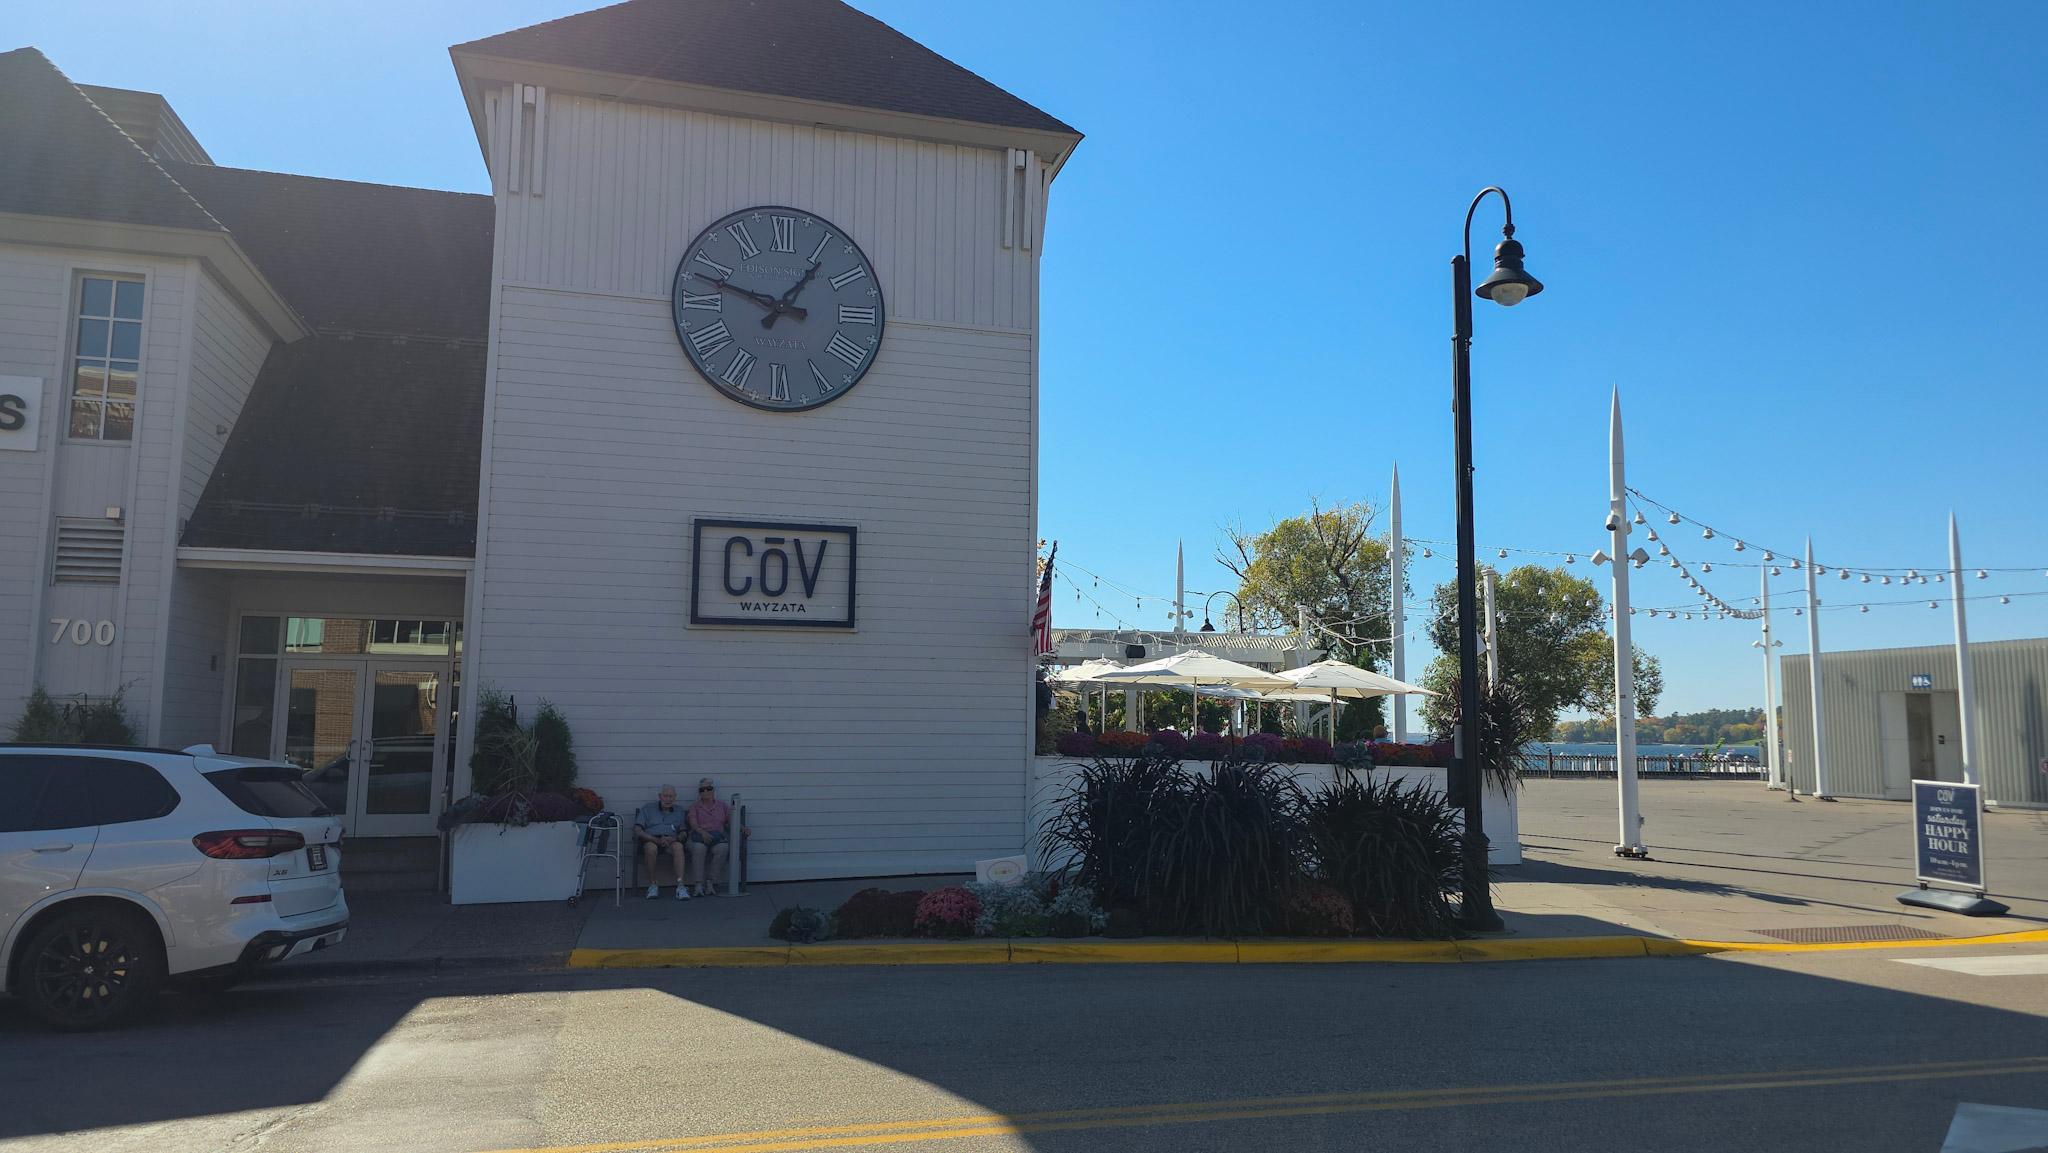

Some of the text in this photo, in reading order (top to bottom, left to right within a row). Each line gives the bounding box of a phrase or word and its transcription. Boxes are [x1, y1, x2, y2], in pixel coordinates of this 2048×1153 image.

[725, 220, 761, 261] XI
[770, 215, 796, 253] XII
[694, 249, 734, 280] X
[828, 264, 867, 291] II
[682, 290, 722, 313] IX
[838, 304, 877, 326] III
[687, 318, 735, 361] VIII
[754, 336, 807, 350] WAYZATA
[721, 347, 758, 391] VII
[808, 359, 834, 394] V
[740, 602, 806, 613] WAYZATA
[49, 618, 116, 647] 700
[1925, 823, 1971, 840] HAPPY
[1928, 837, 1968, 854] HOUR
